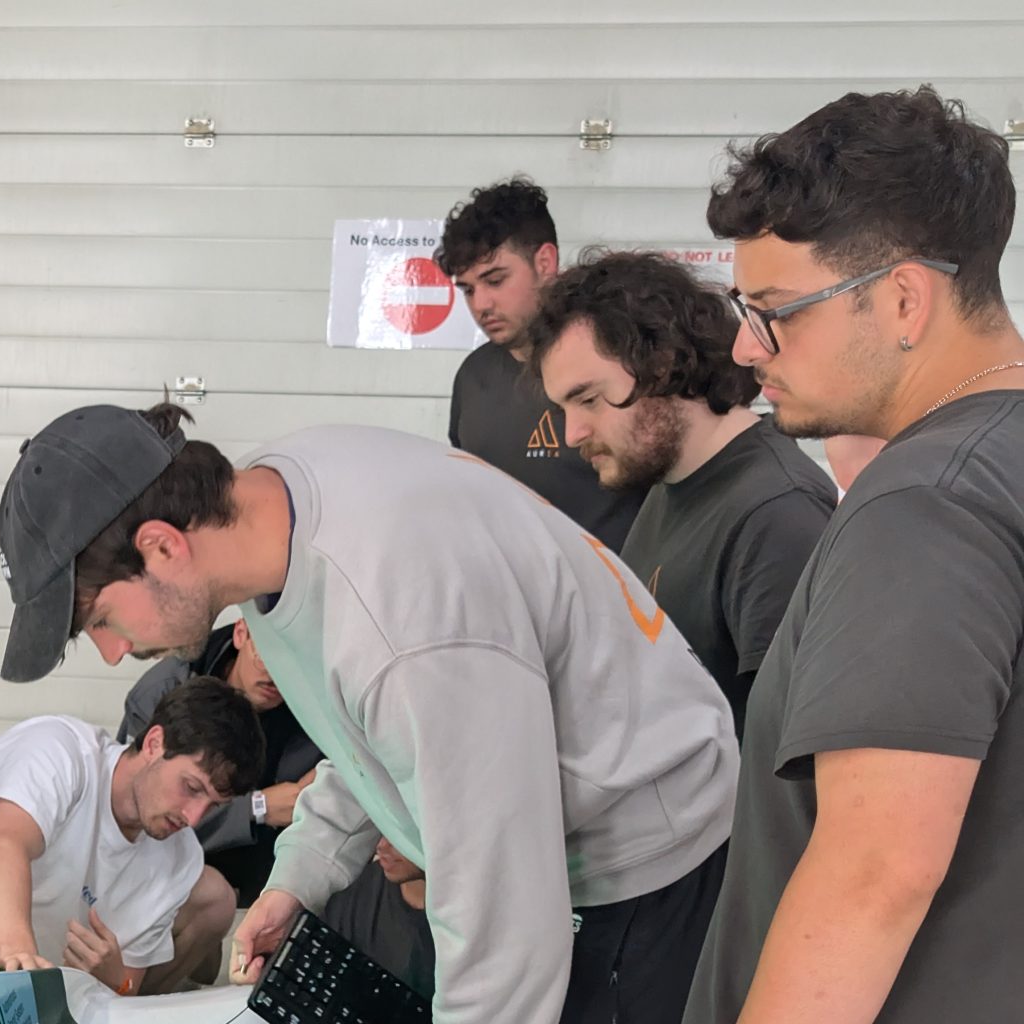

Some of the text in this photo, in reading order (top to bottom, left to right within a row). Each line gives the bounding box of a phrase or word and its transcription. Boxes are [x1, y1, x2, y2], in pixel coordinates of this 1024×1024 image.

[350, 234, 435, 246] No Access to
[685, 251, 712, 262] NOT
